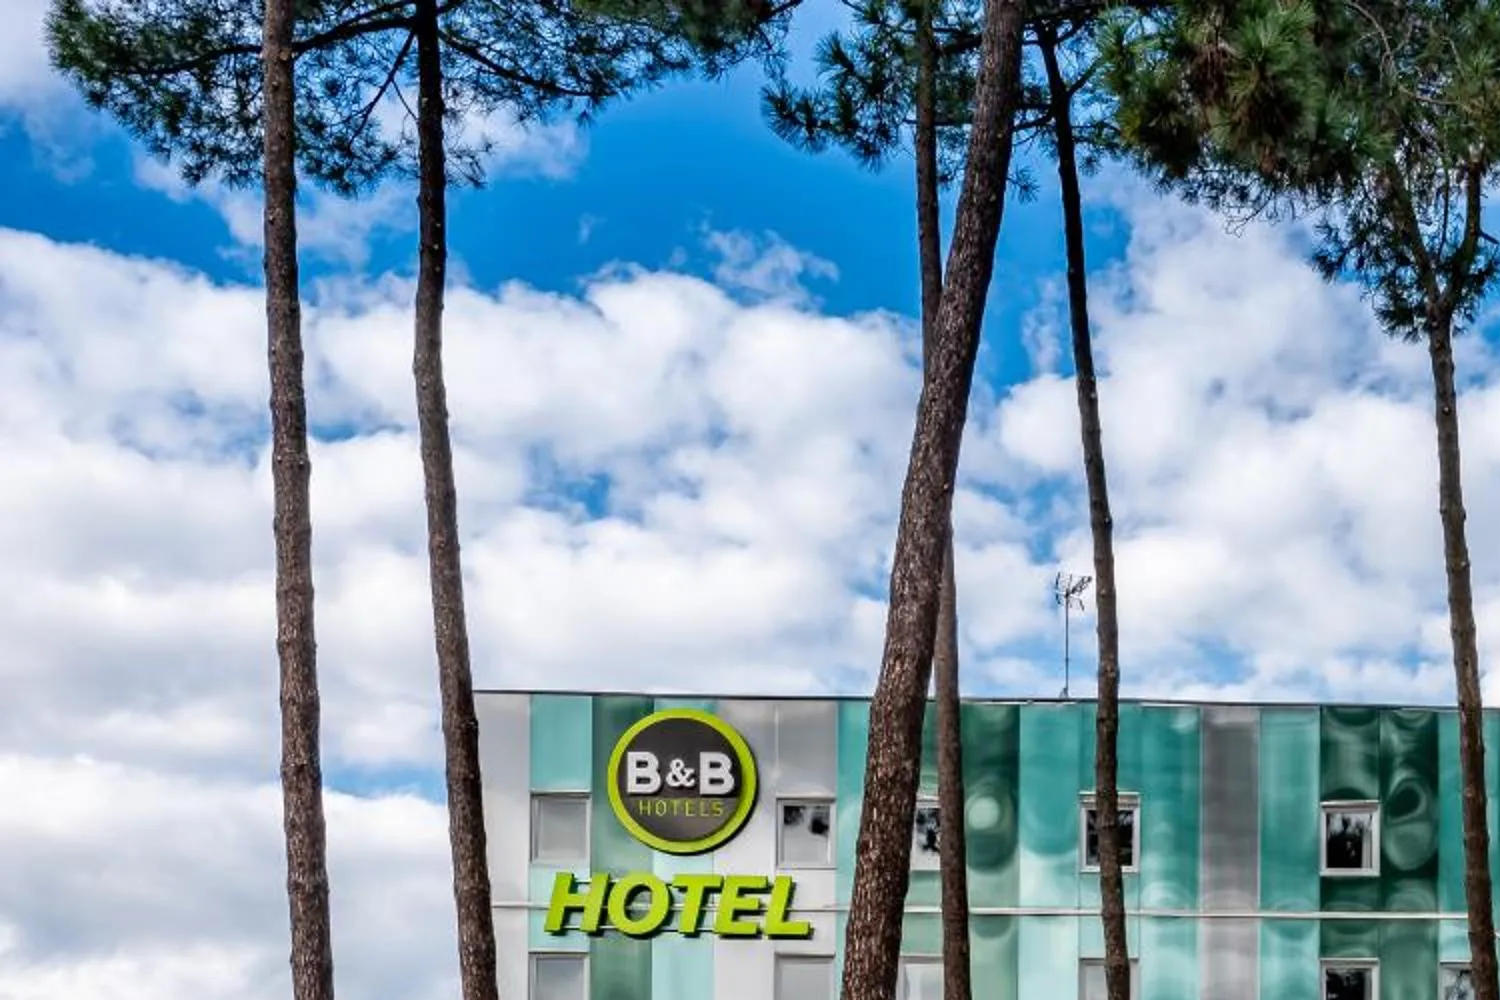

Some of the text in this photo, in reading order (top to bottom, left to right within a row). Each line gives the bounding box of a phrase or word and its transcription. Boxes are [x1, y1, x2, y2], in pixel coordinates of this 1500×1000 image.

[626, 752, 735, 794] B&B
[638, 801, 725, 817] HOTELS
[544, 872, 813, 936] HOTEL
